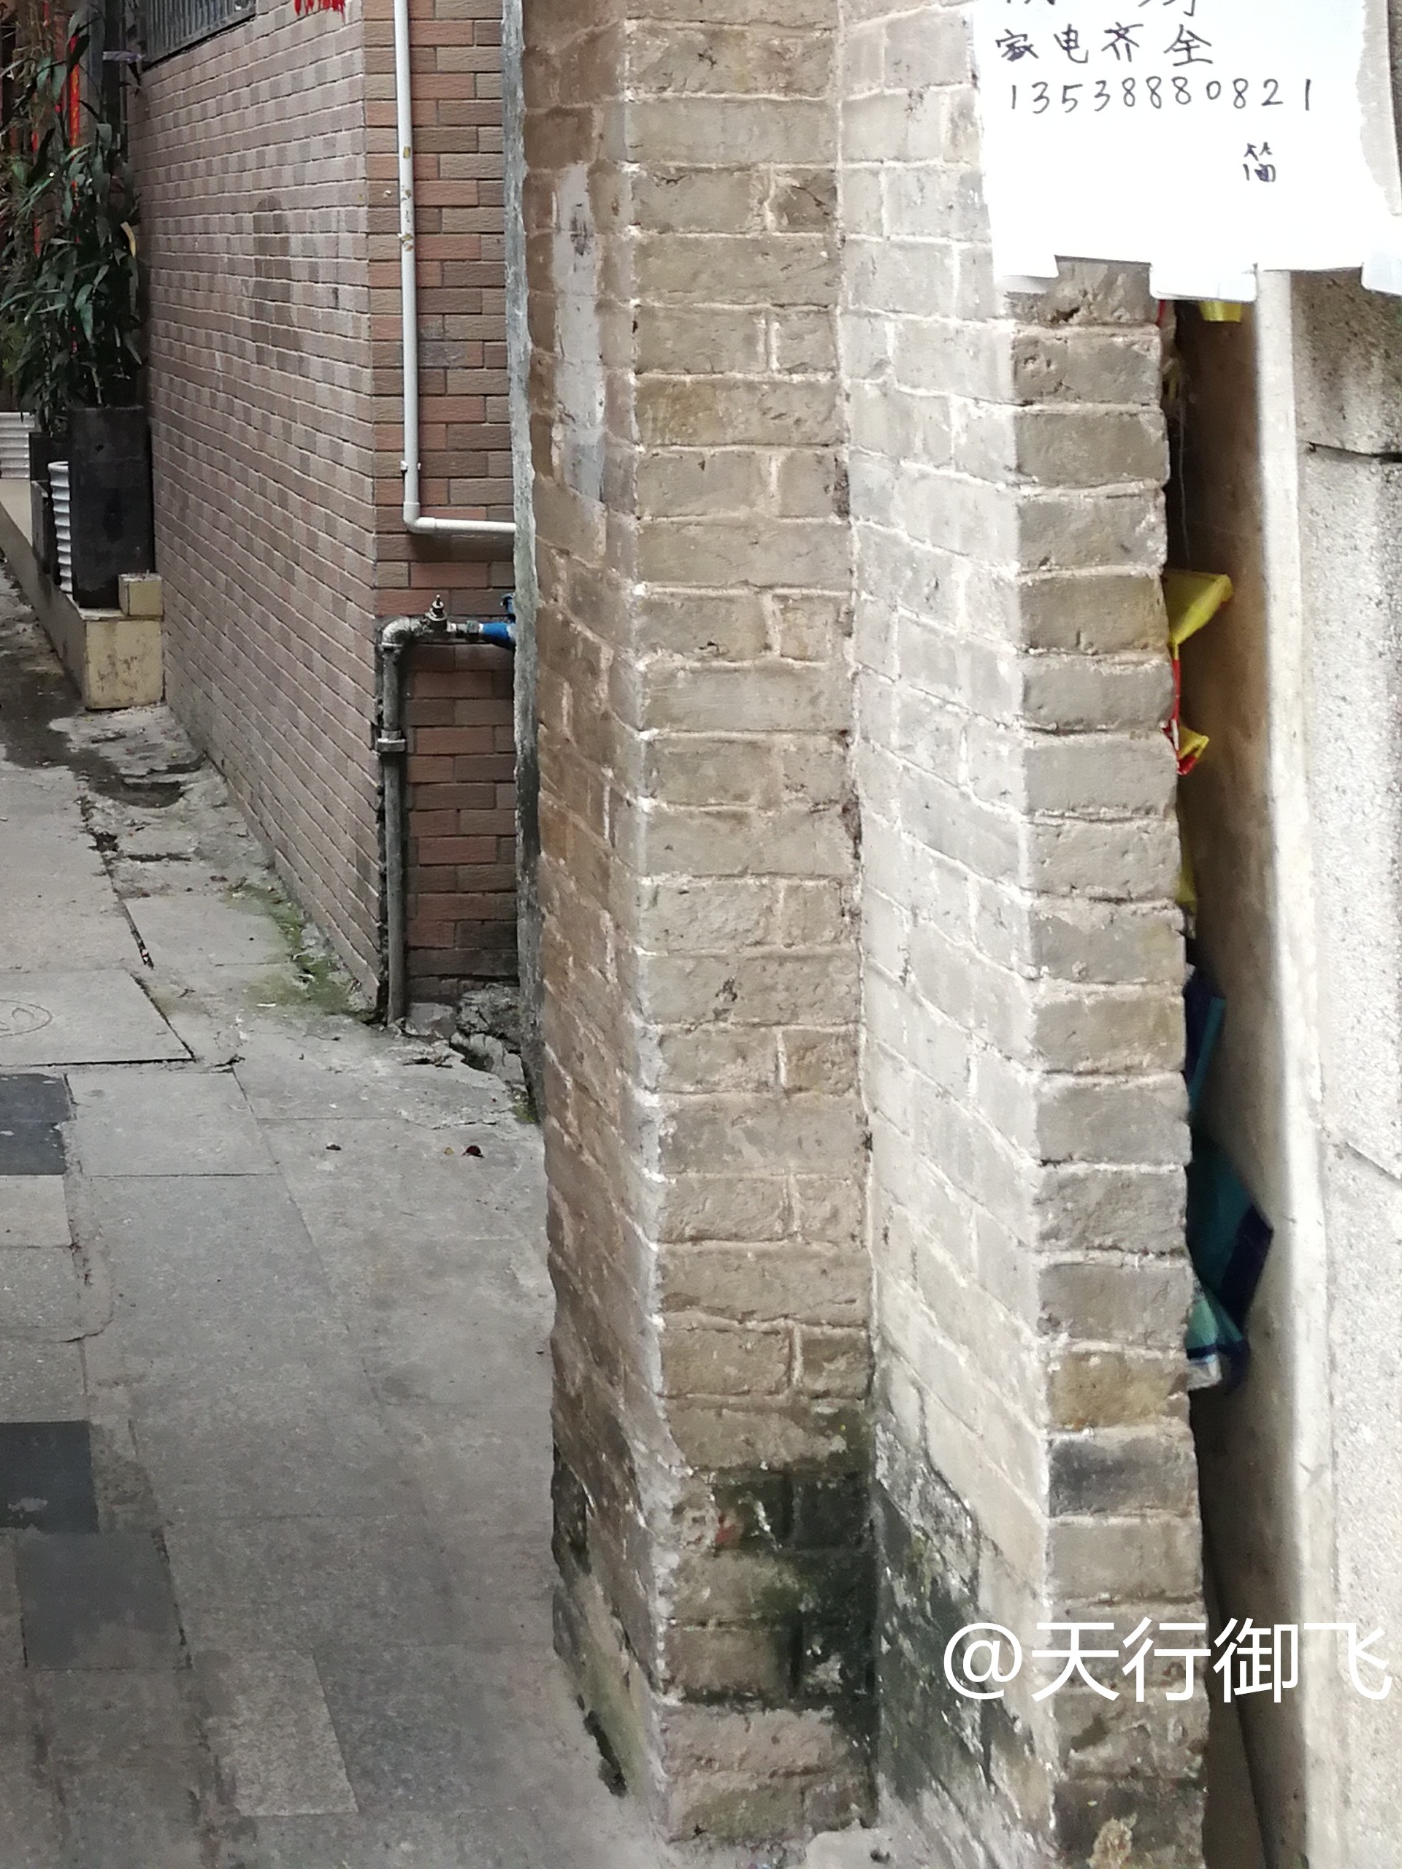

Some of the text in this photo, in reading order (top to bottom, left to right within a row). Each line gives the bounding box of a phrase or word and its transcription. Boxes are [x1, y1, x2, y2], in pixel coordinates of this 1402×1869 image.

[995, 22, 1214, 67] 家电齐全
[1011, 76, 1311, 114] 13538880821
